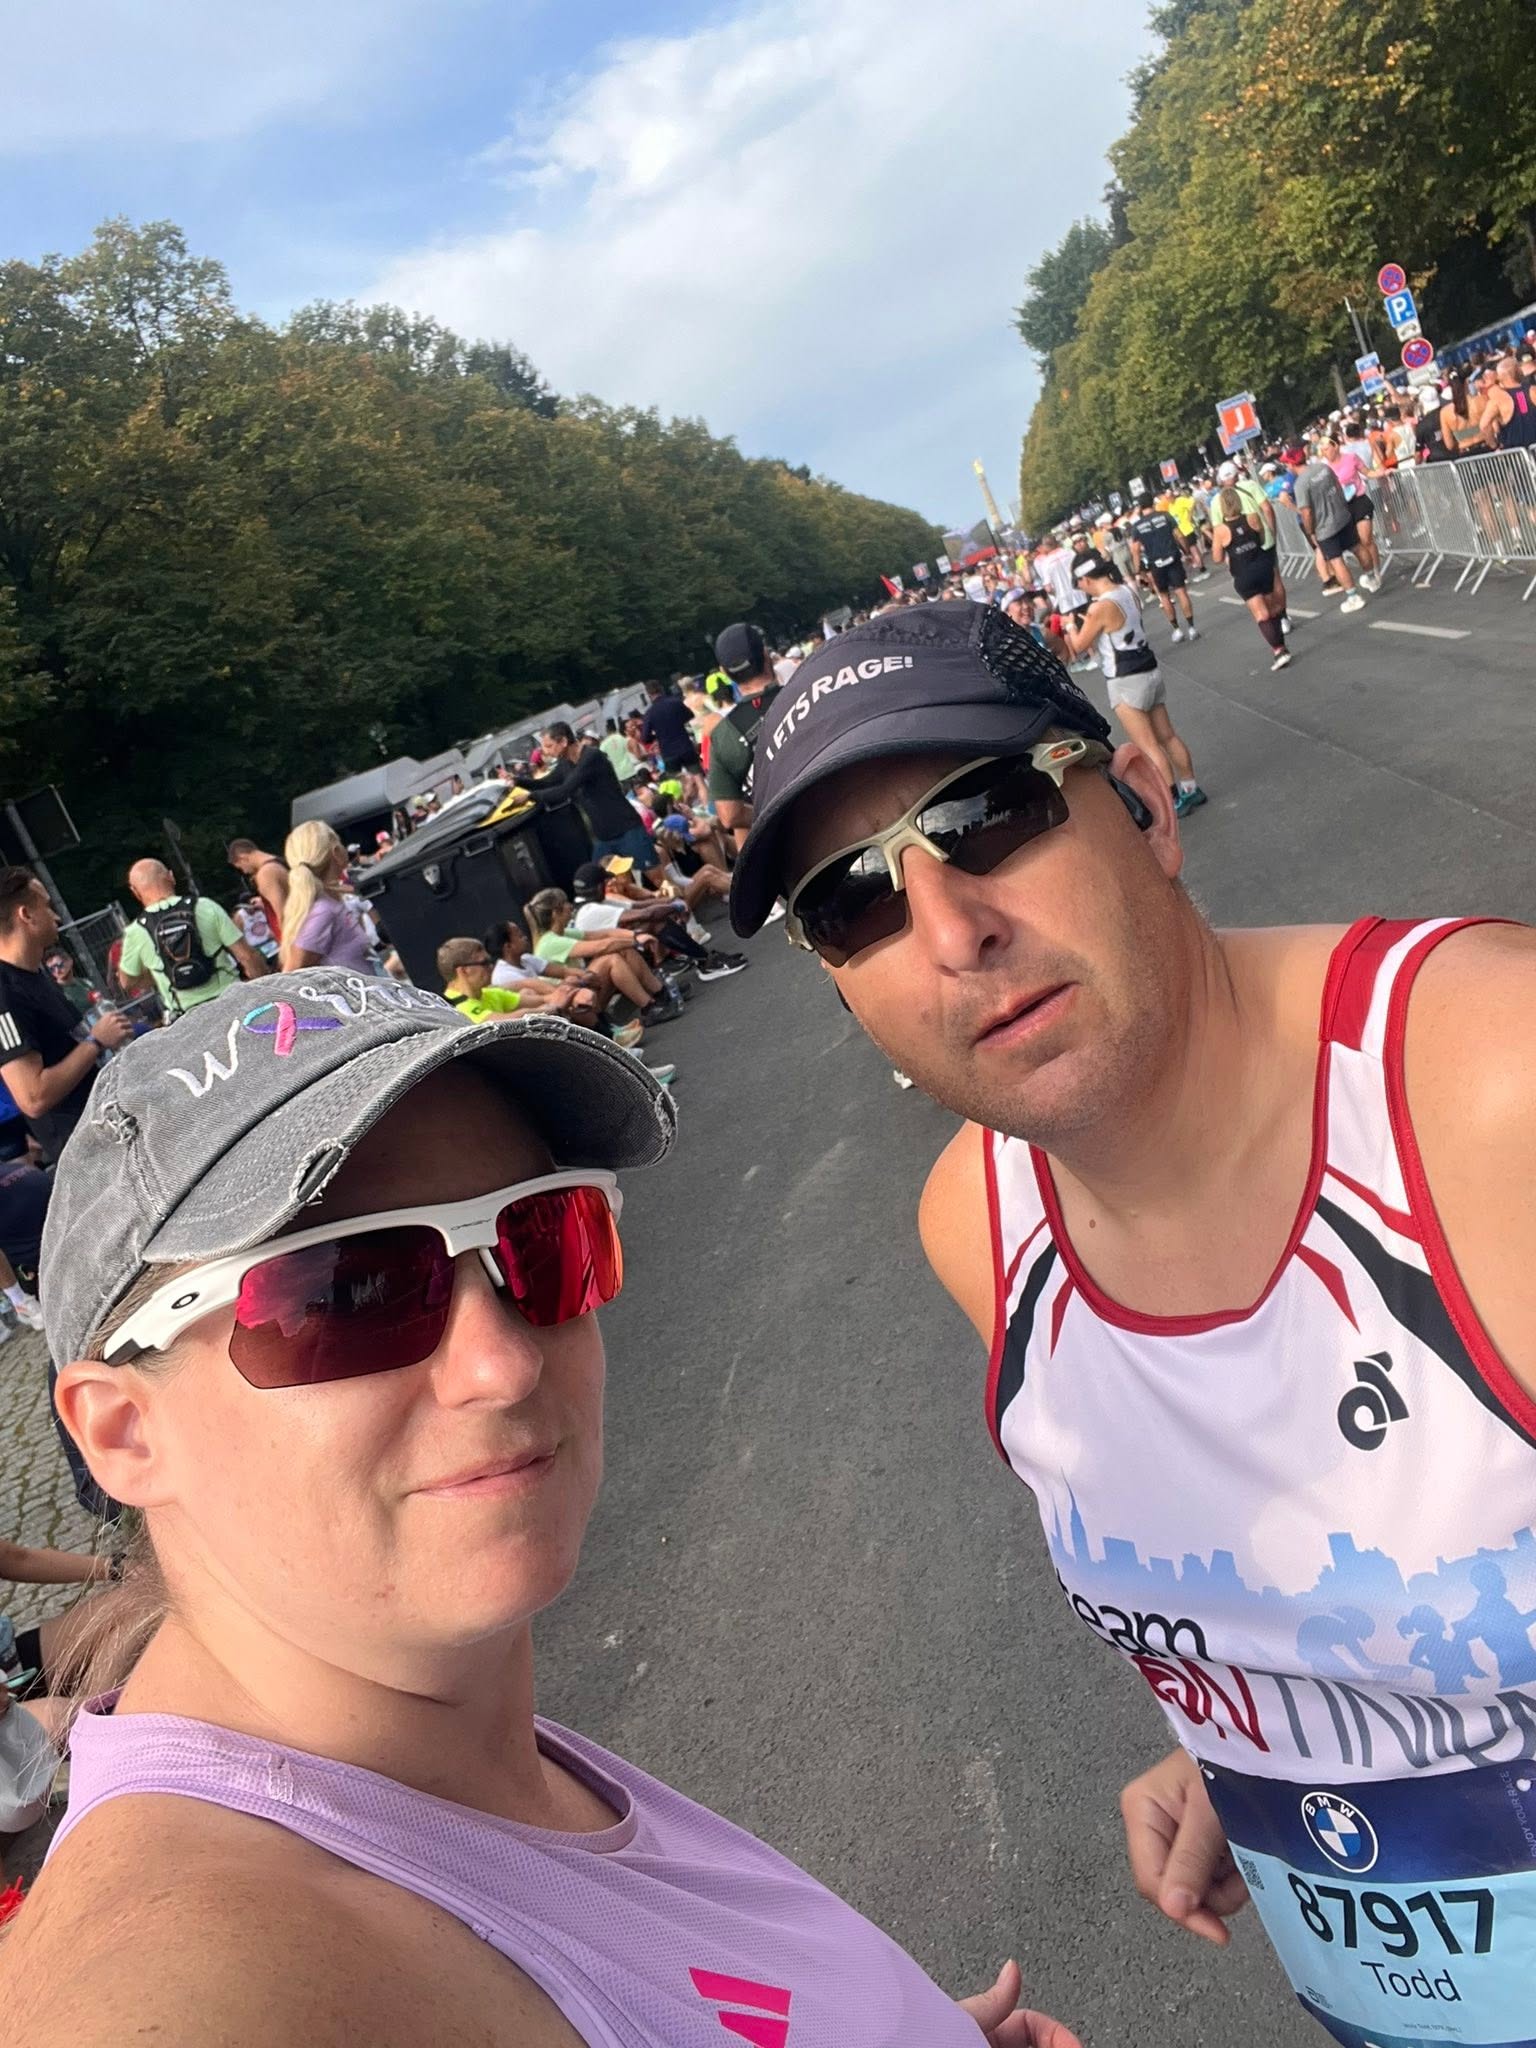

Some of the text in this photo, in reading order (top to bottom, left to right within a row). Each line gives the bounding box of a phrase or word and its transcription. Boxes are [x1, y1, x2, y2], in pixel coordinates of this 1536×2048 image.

[1391, 296, 1407, 322] P
[1234, 406, 1246, 433] J
[811, 655, 914, 704] RAGE!
[1305, 1796, 1355, 1818] BMW
[1511, 1797, 1528, 1827] YOUR
[1288, 1872, 1495, 1958] 87917
[1360, 1960, 1462, 2002] Todd
